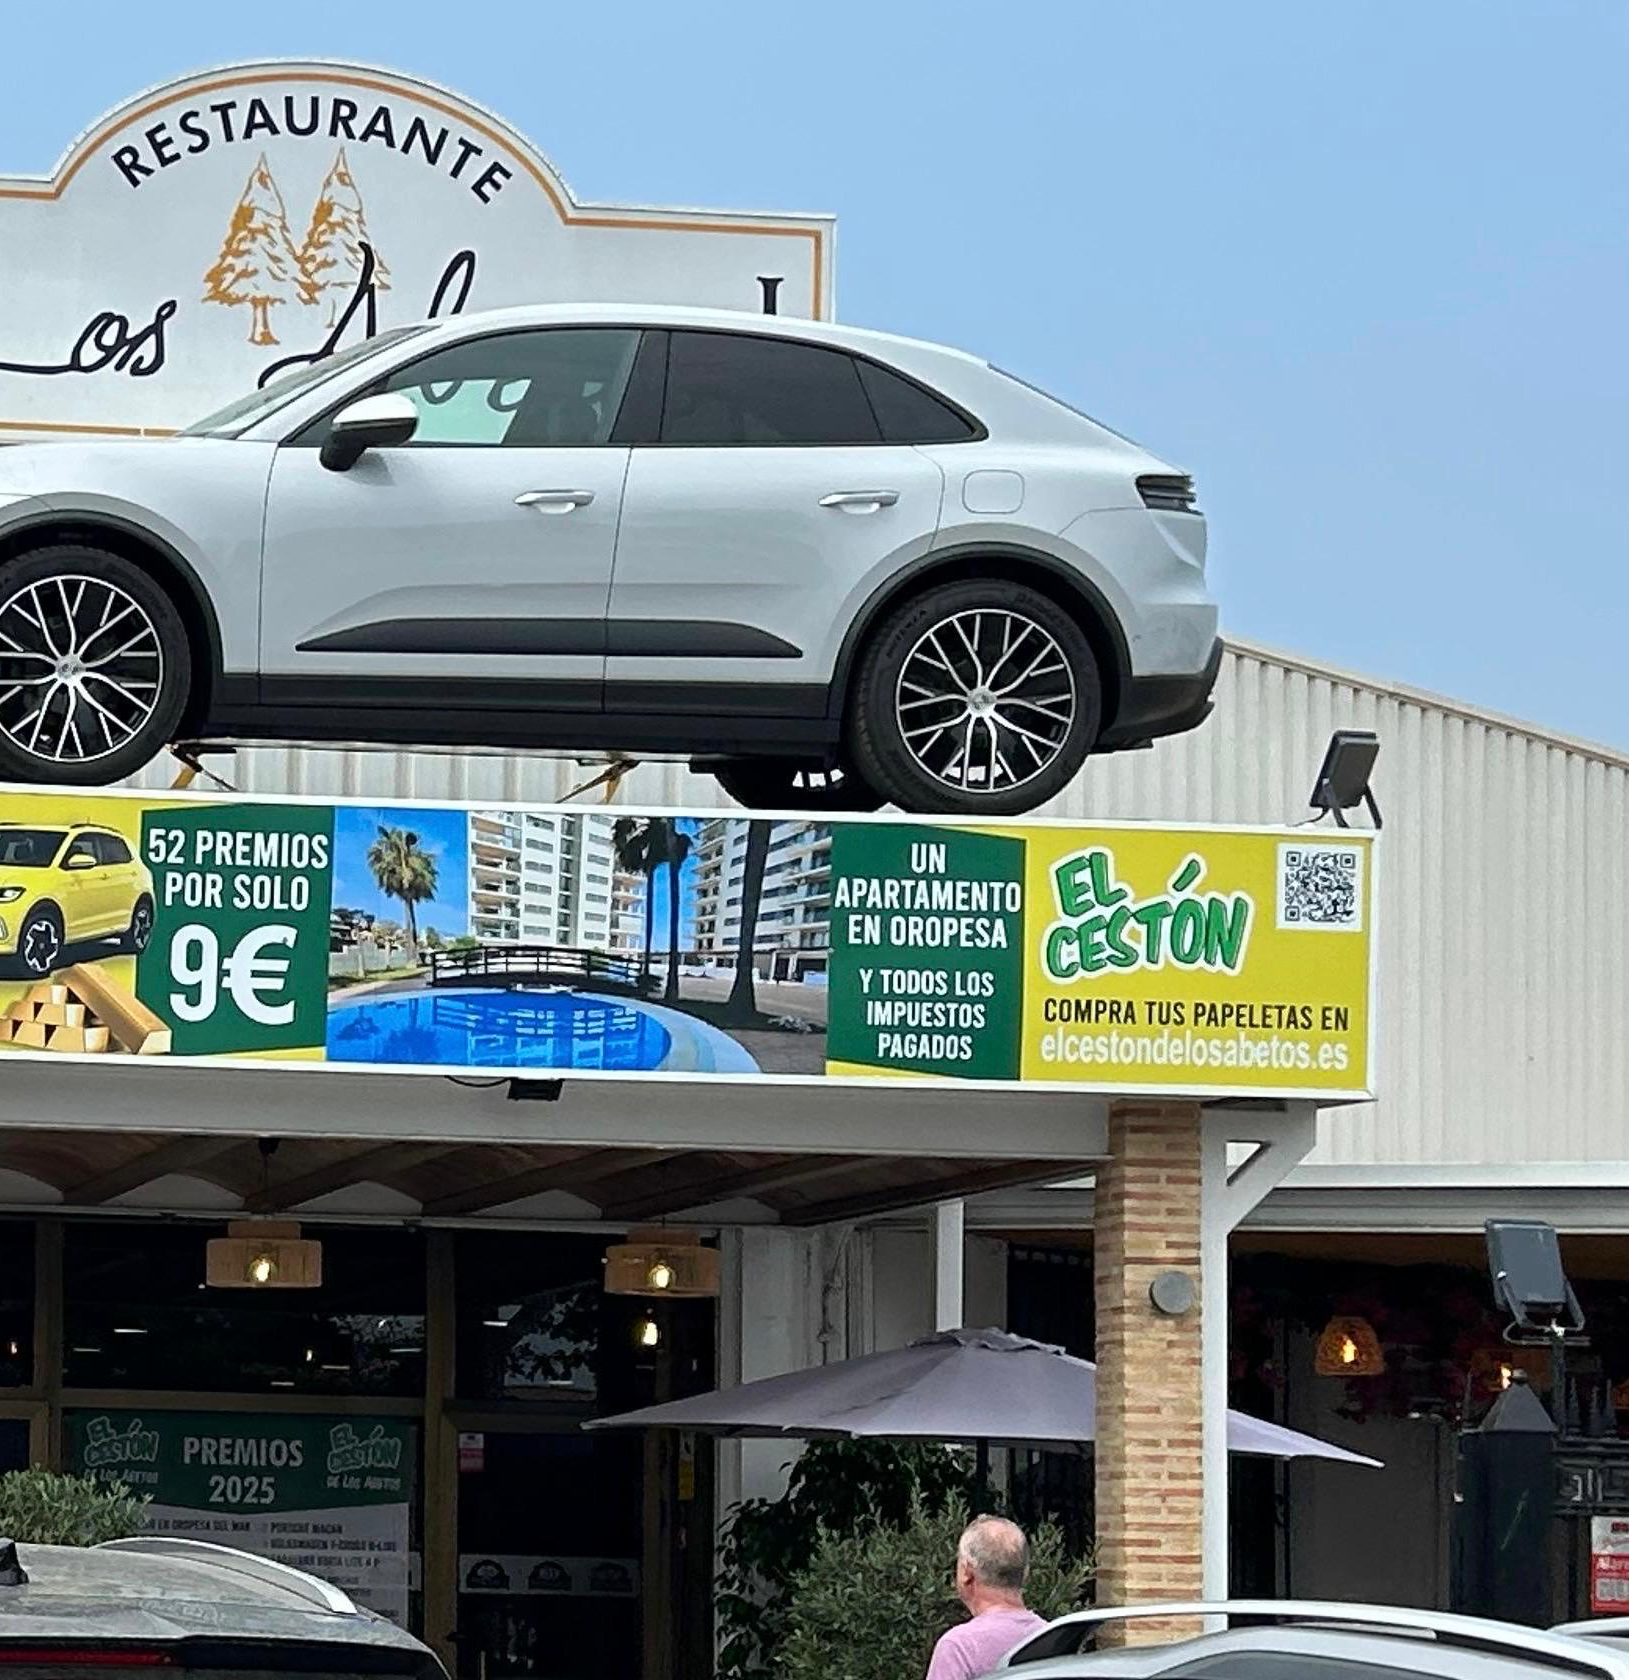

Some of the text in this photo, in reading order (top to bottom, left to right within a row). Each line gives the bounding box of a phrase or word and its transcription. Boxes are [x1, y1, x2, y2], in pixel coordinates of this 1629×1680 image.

[112, 96, 512, 204] RESTAURANTE
[148, 827, 329, 869] 52 PREMIOS
[911, 842, 947, 874] UN
[165, 871, 310, 911] POR SOLO
[834, 876, 1022, 913] APARTAMENTO
[1055, 851, 1128, 918] EL
[848, 914, 1008, 949] EN OROPESA
[1046, 858, 1249, 979] CESTÓN
[169, 923, 298, 1026] 9€
[859, 968, 995, 997] Y TODOS LOS
[866, 1000, 986, 1029] IMPUESTOS
[1044, 997, 1349, 1031] COMPRA TUS PAPELETAS EN
[877, 1032, 973, 1060] PAGADOS
[1041, 1026, 1349, 1070] elcestondelosabetos.es
[183, 1436, 305, 1468] PREMIOS
[208, 1474, 276, 1504] 2025
